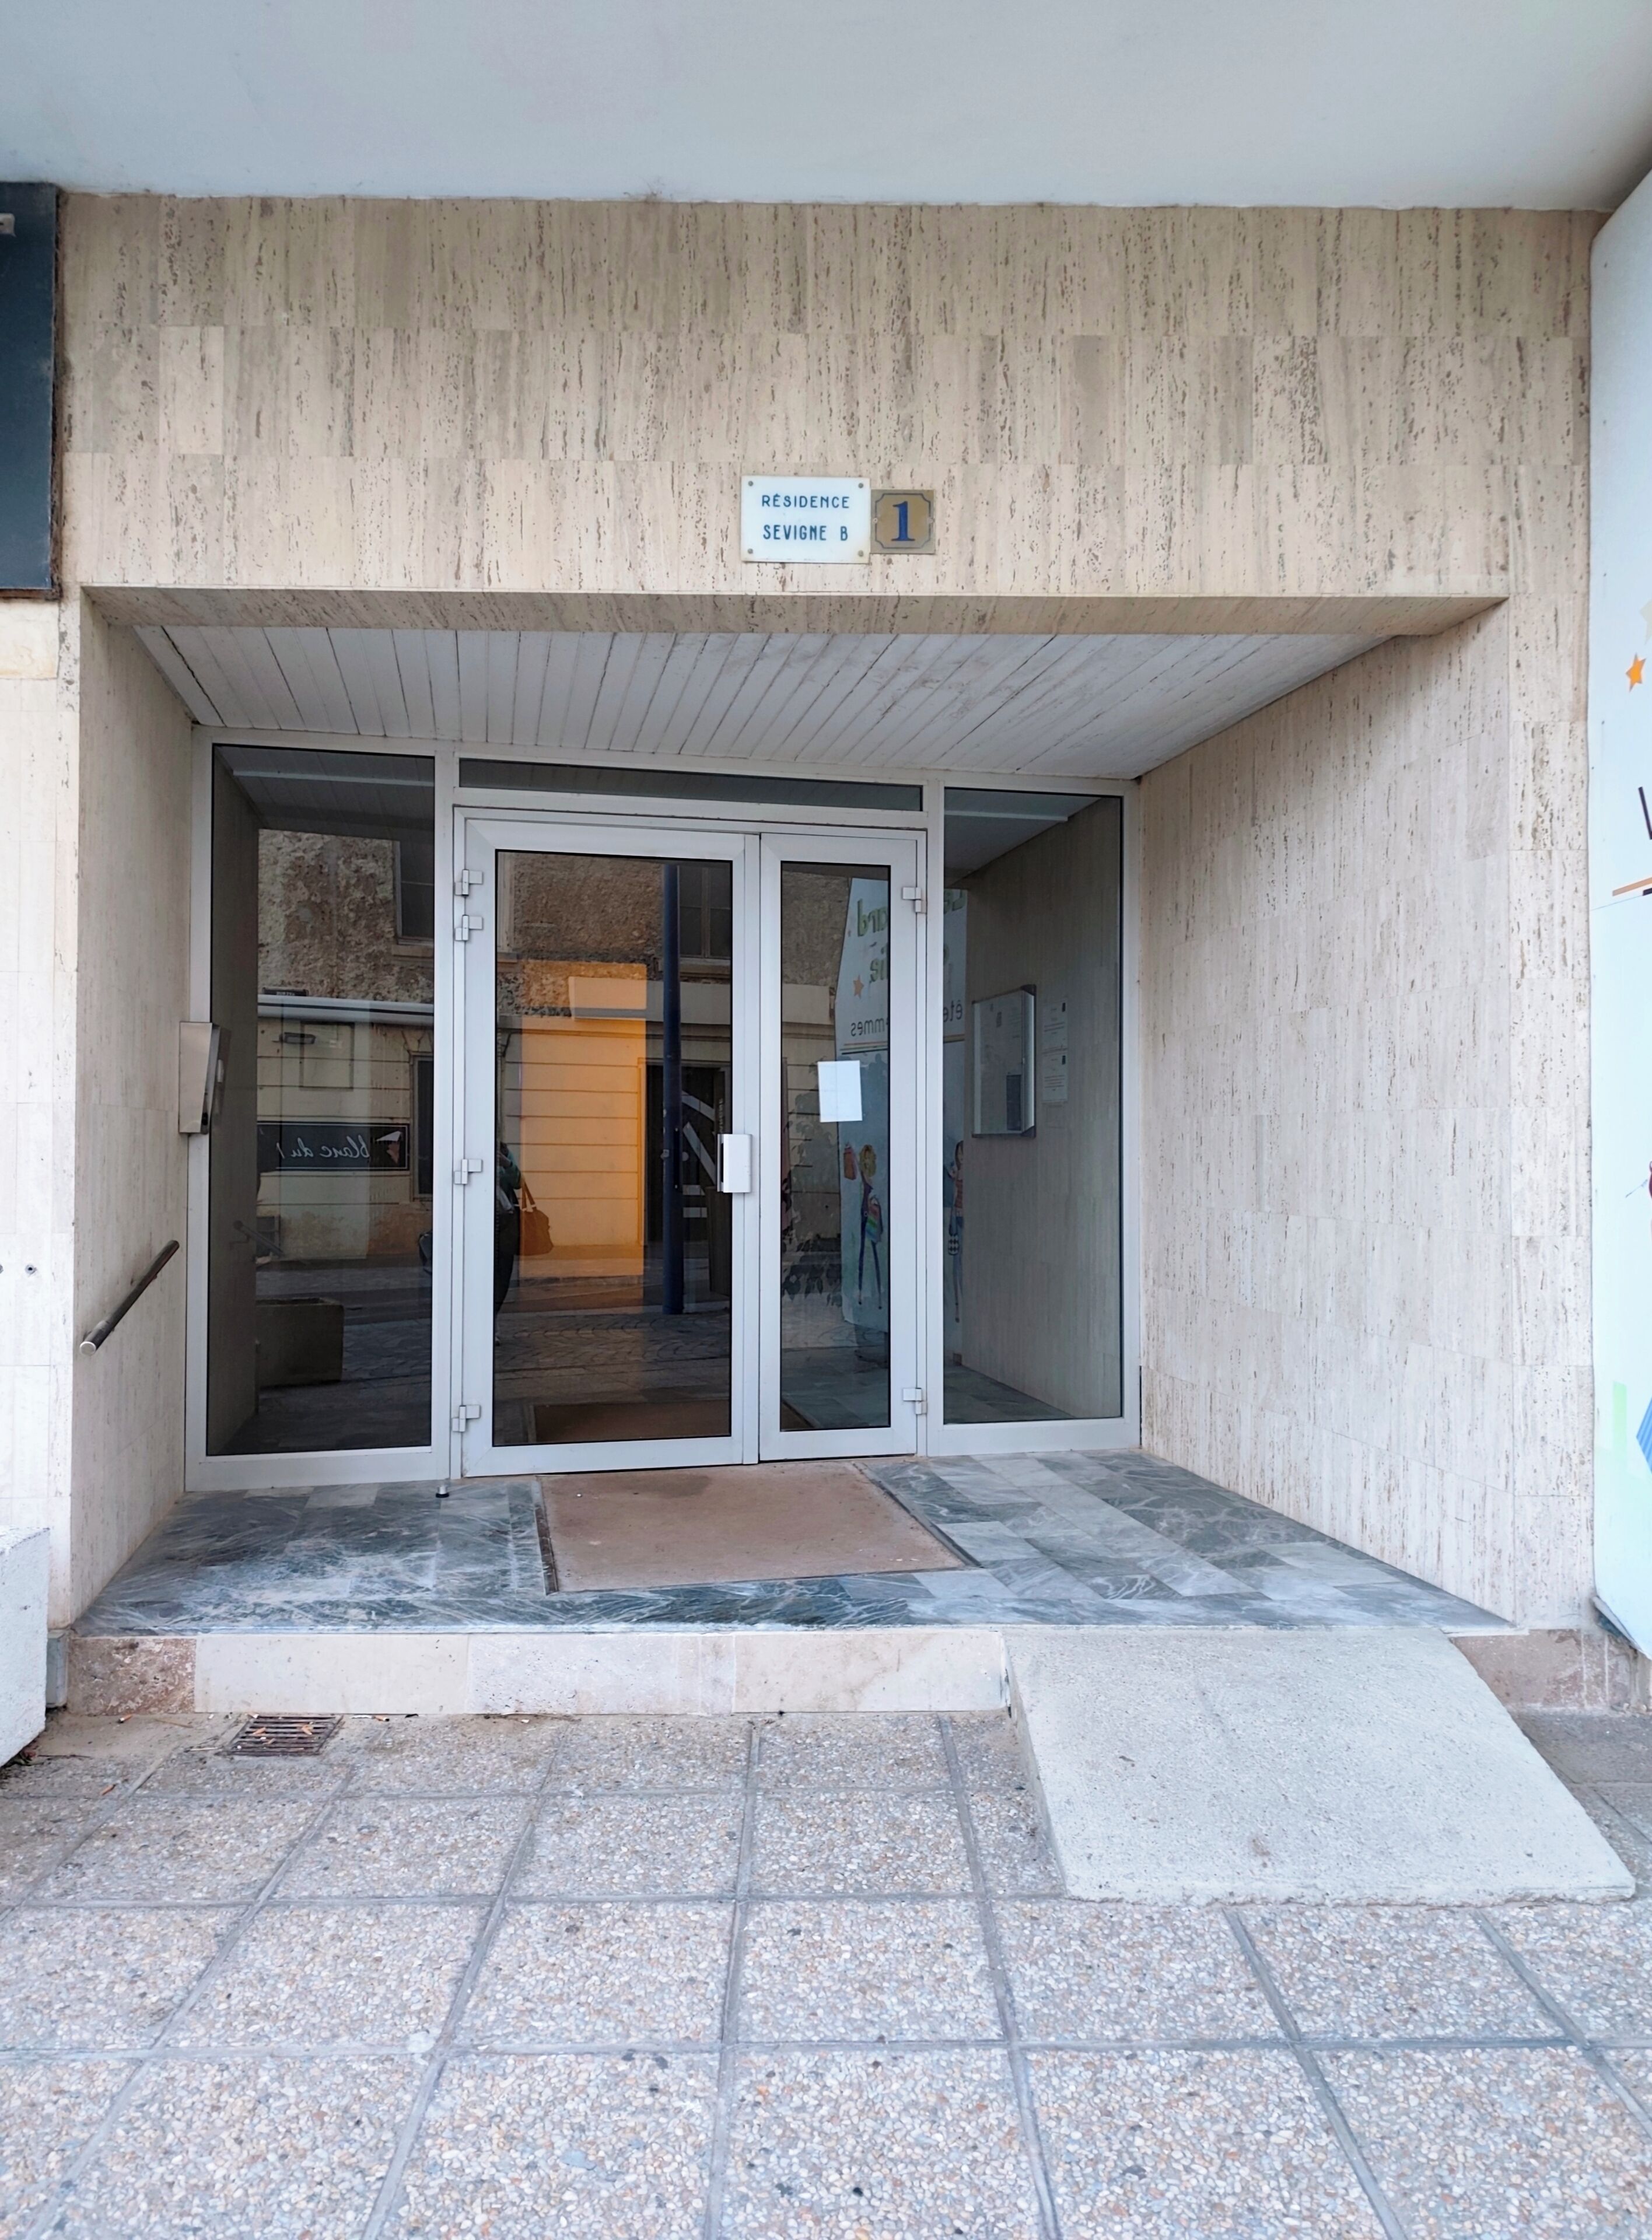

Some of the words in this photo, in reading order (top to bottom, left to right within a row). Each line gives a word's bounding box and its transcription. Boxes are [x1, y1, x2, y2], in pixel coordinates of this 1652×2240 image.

[761, 494, 850, 509] RÉSIDENCE
[891, 501, 915, 541] 1
[763, 524, 827, 541] SEVIGNE
[840, 526, 849, 541] B
